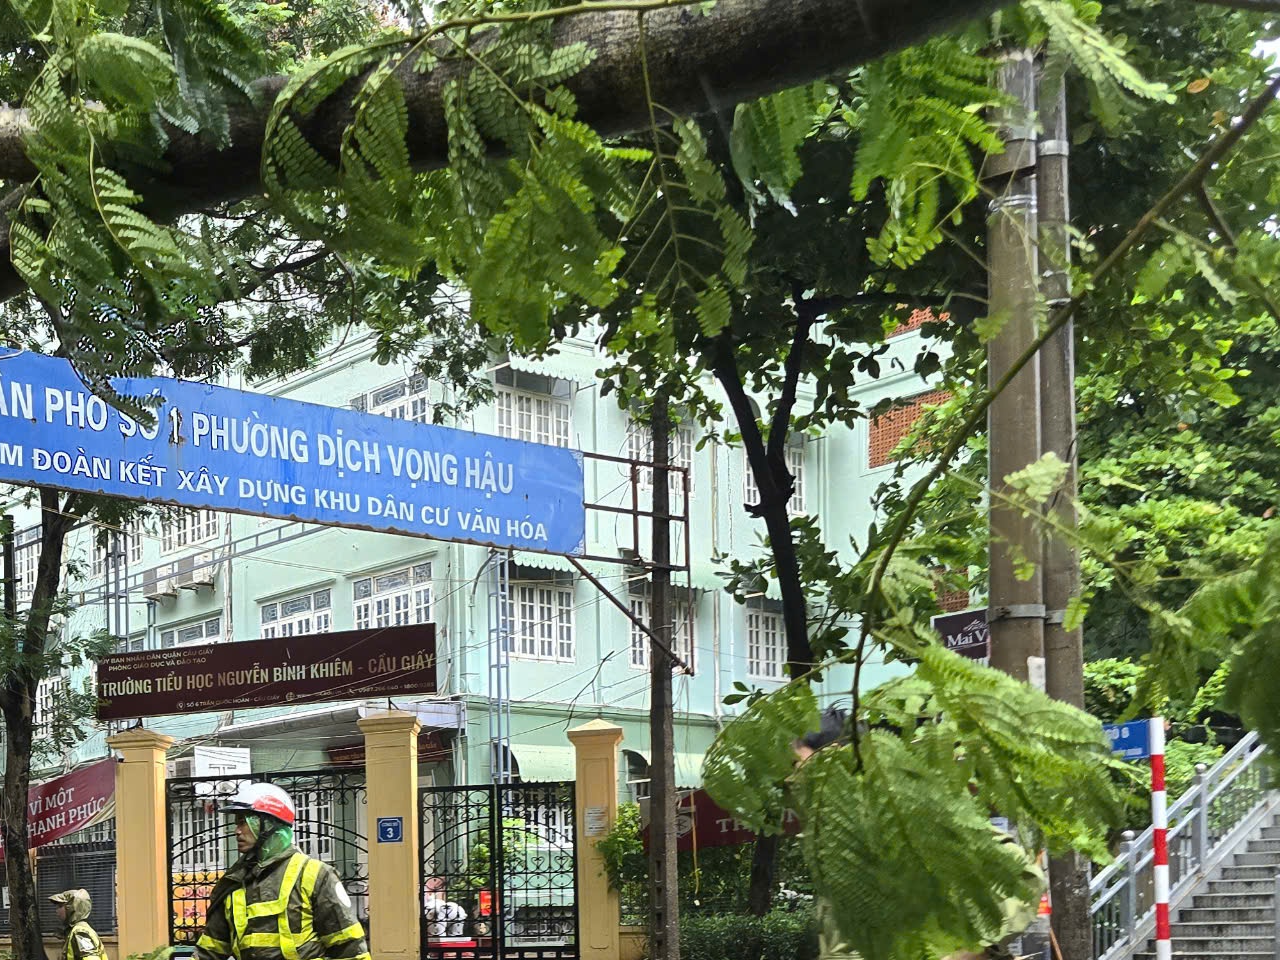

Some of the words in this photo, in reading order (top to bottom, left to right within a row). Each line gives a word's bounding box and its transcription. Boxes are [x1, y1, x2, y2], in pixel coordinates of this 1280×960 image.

[192, 411, 308, 463] PHƯỜNG
[318, 429, 381, 477] DỊCH
[387, 445, 458, 489] VỌNG
[465, 451, 513, 498] HẬU
[32, 447, 112, 481] ĐOÀN
[119, 454, 167, 487] KẾT
[177, 466, 229, 496] XÂY
[239, 479, 306, 508] DỰNG
[314, 488, 360, 513] KHU
[367, 494, 414, 522] DÂN
[421, 505, 450, 527] CƯ
[457, 508, 500, 535] VĂN
[507, 515, 548, 541] HÓA
[946, 632, 973, 648] Mai
[102, 677, 152, 697] TRƯỜNG
[155, 671, 182, 693] TIỂU
[186, 673, 213, 692] HỌC
[217, 662, 269, 687] NGUYỄN
[273, 661, 306, 682] BỈNH
[310, 657, 353, 679] KHIÊM
[368, 652, 396, 674] CẦU
[401, 649, 434, 671] GIẤY
[108, 663, 132, 672] PHÒNG
[165, 659, 175, 667] VÀ
[111, 656, 125, 664] BAN
[126, 654, 145, 663] NHÂN
[146, 653, 161, 661] DÂN
[29, 795, 43, 816] VÌ
[45, 787, 75, 810] MỘT
[26, 811, 66, 838] HẠNH
[68, 797, 106, 824] PHÚC
[386, 827, 394, 838] 3
